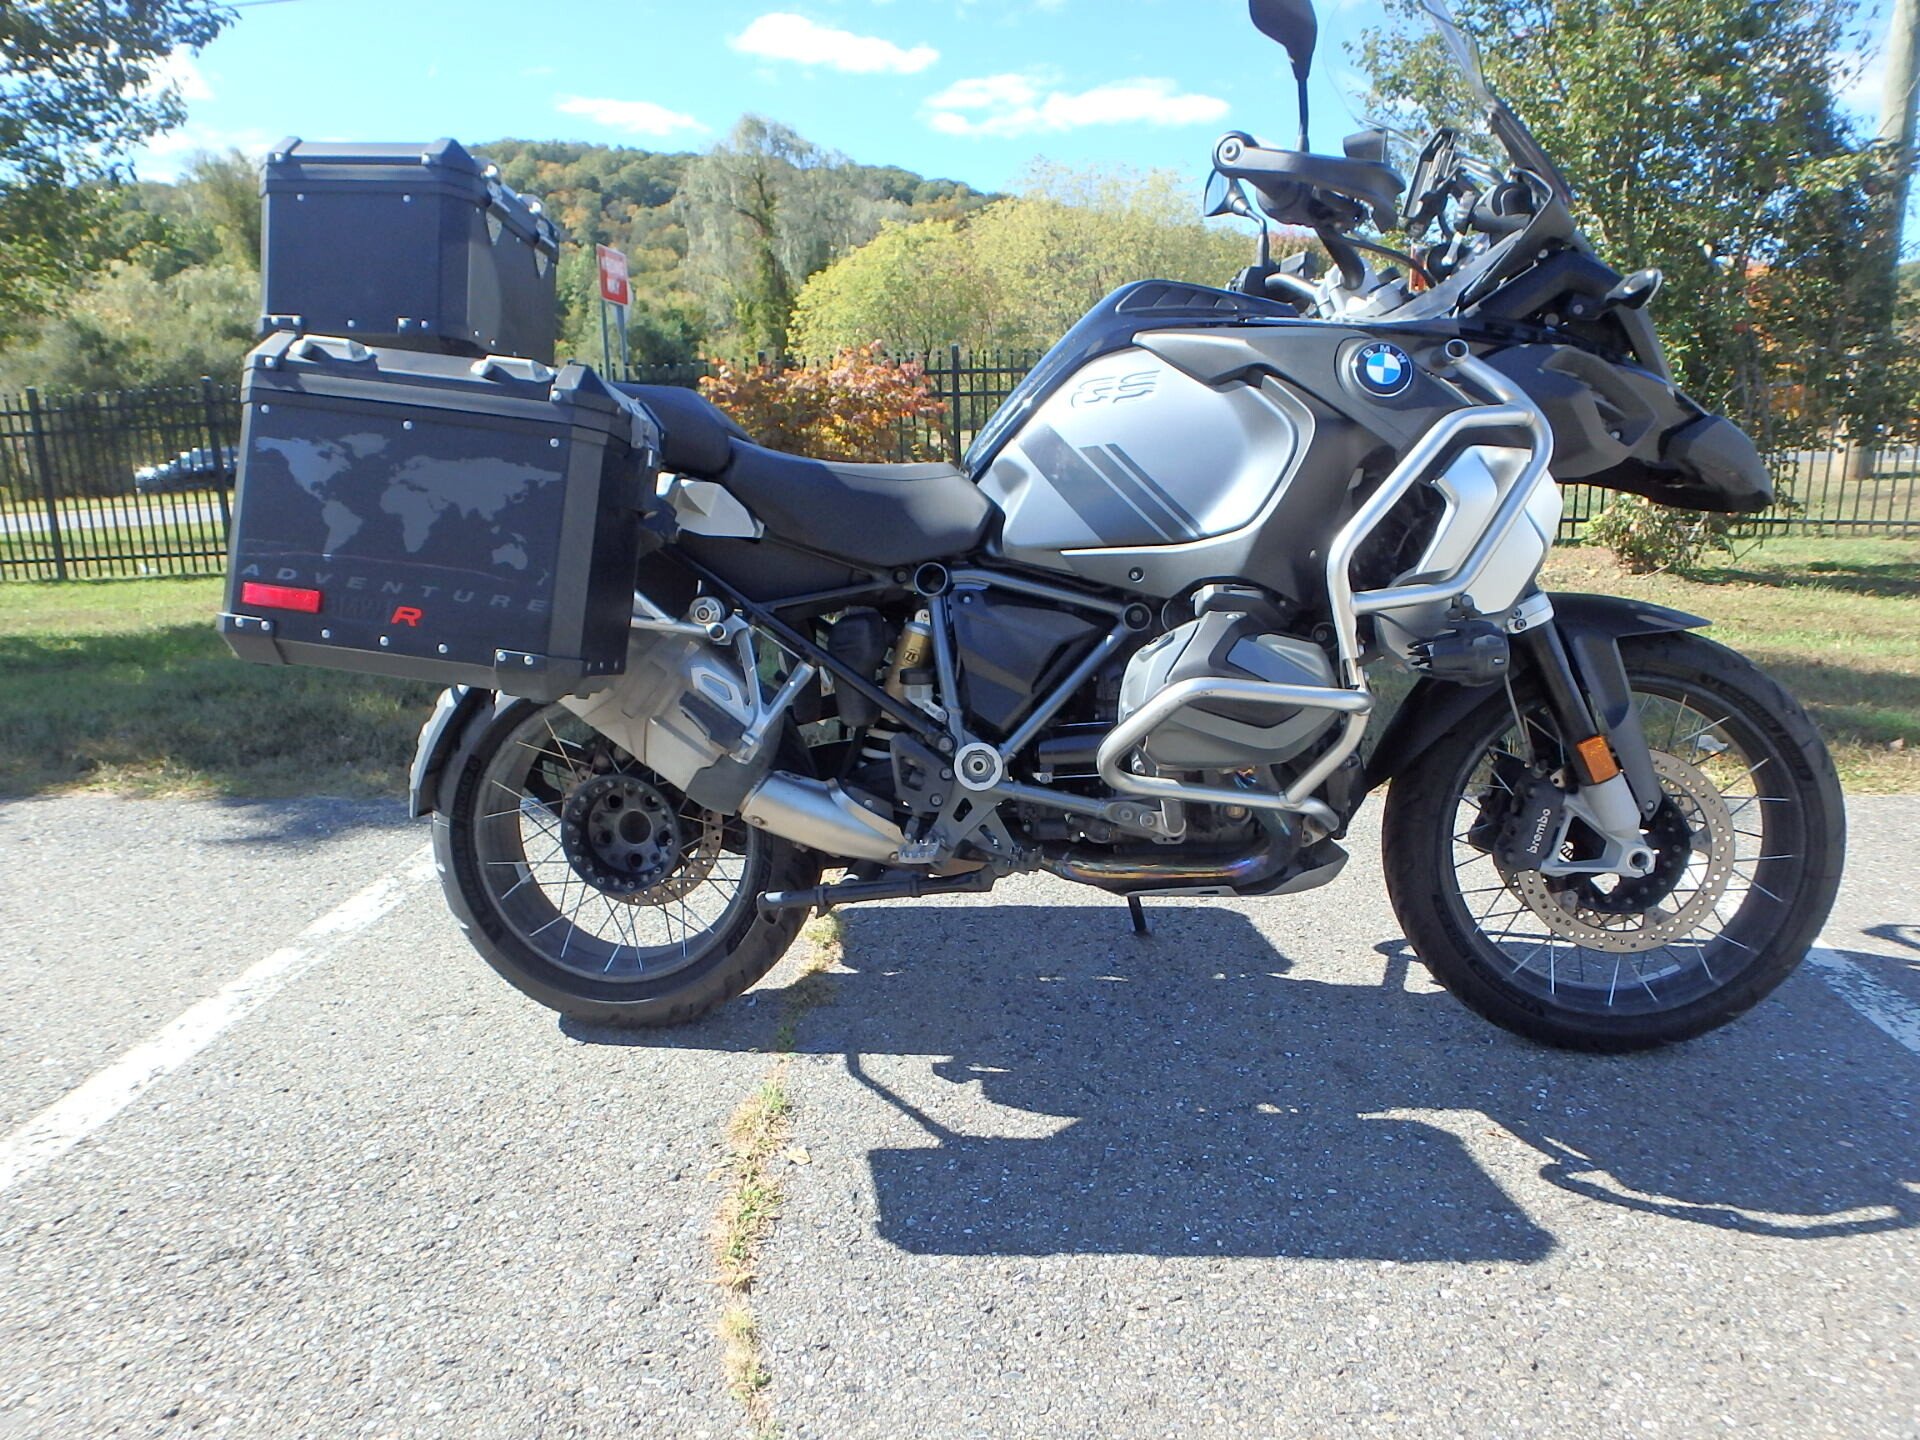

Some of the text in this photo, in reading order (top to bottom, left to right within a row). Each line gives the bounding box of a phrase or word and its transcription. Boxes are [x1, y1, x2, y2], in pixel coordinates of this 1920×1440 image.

[1362, 344, 1407, 363] BMW
[1070, 369, 1161, 409] GS
[240, 563, 547, 613] ADVENTURE
[391, 606, 422, 627] R
[1526, 808, 1551, 854] brembo
